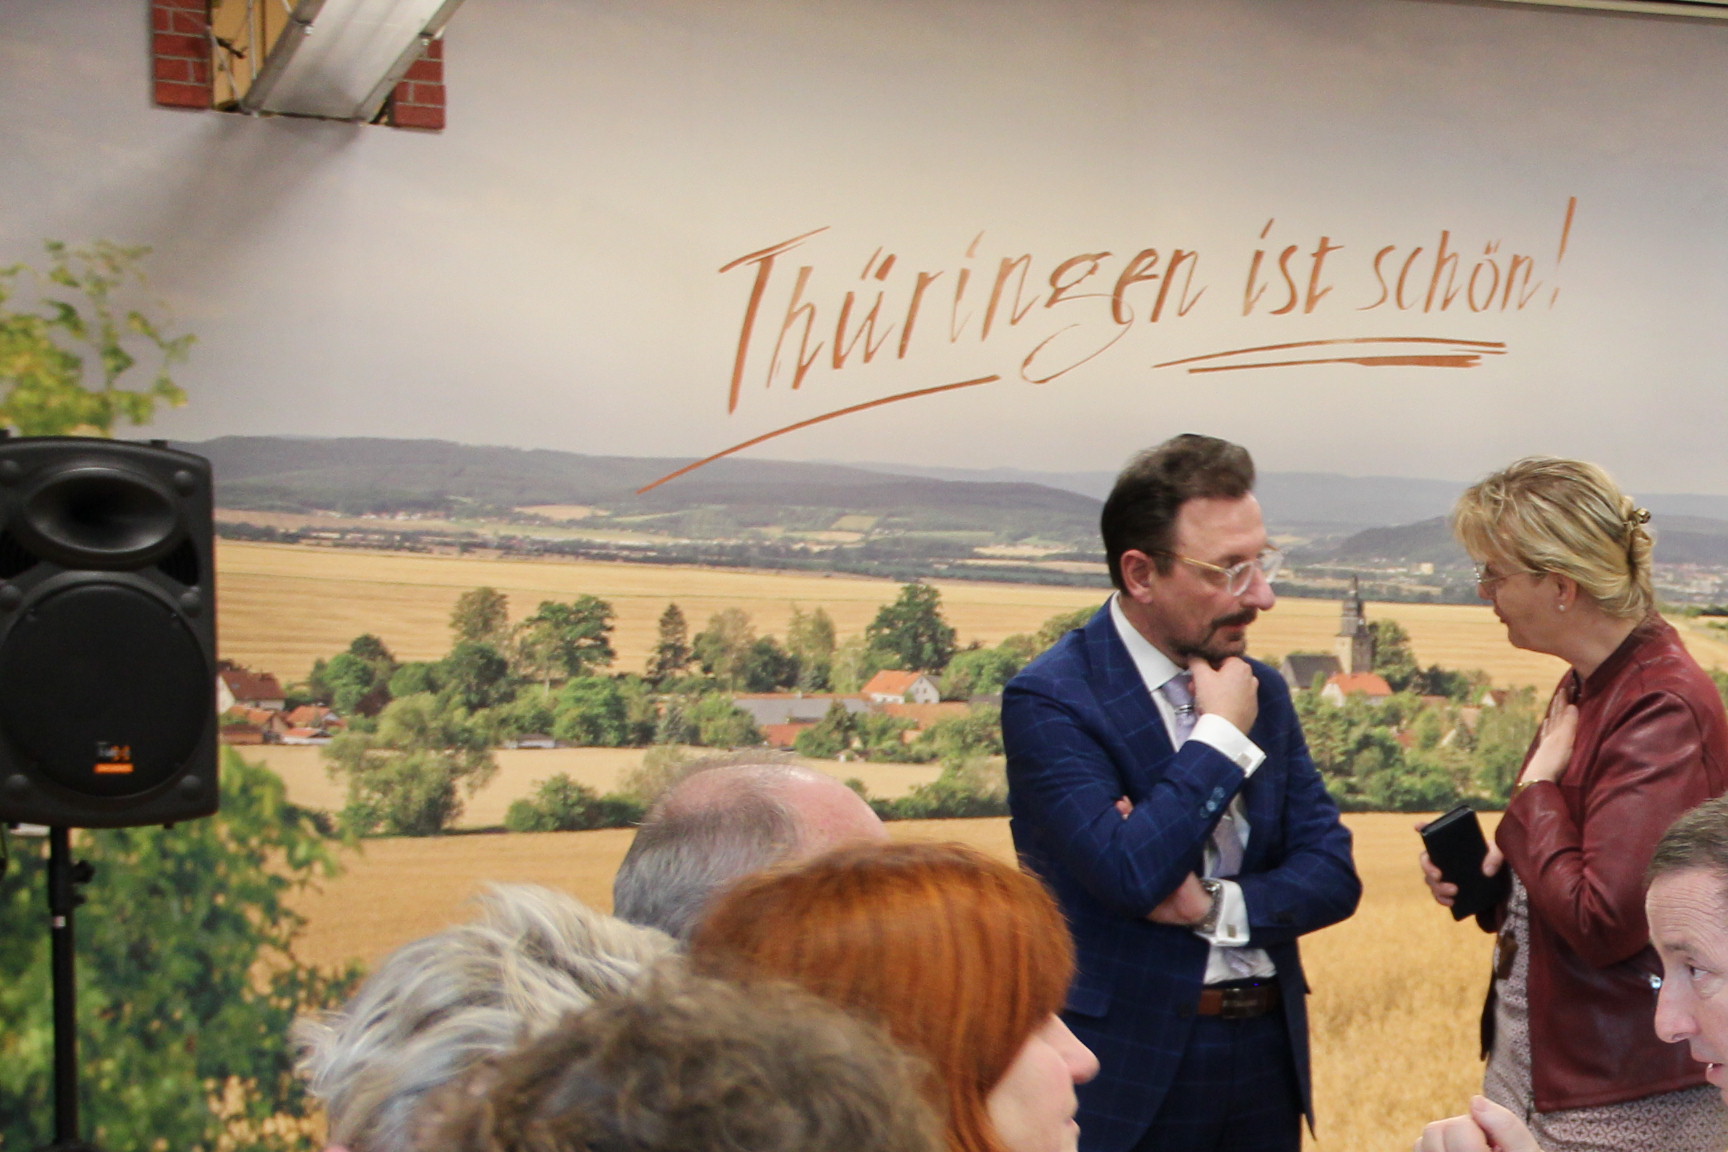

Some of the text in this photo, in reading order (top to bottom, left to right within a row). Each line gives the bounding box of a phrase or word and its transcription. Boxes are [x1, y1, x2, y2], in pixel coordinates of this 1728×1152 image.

[718, 196, 1577, 414] Thüringen ist schön!
